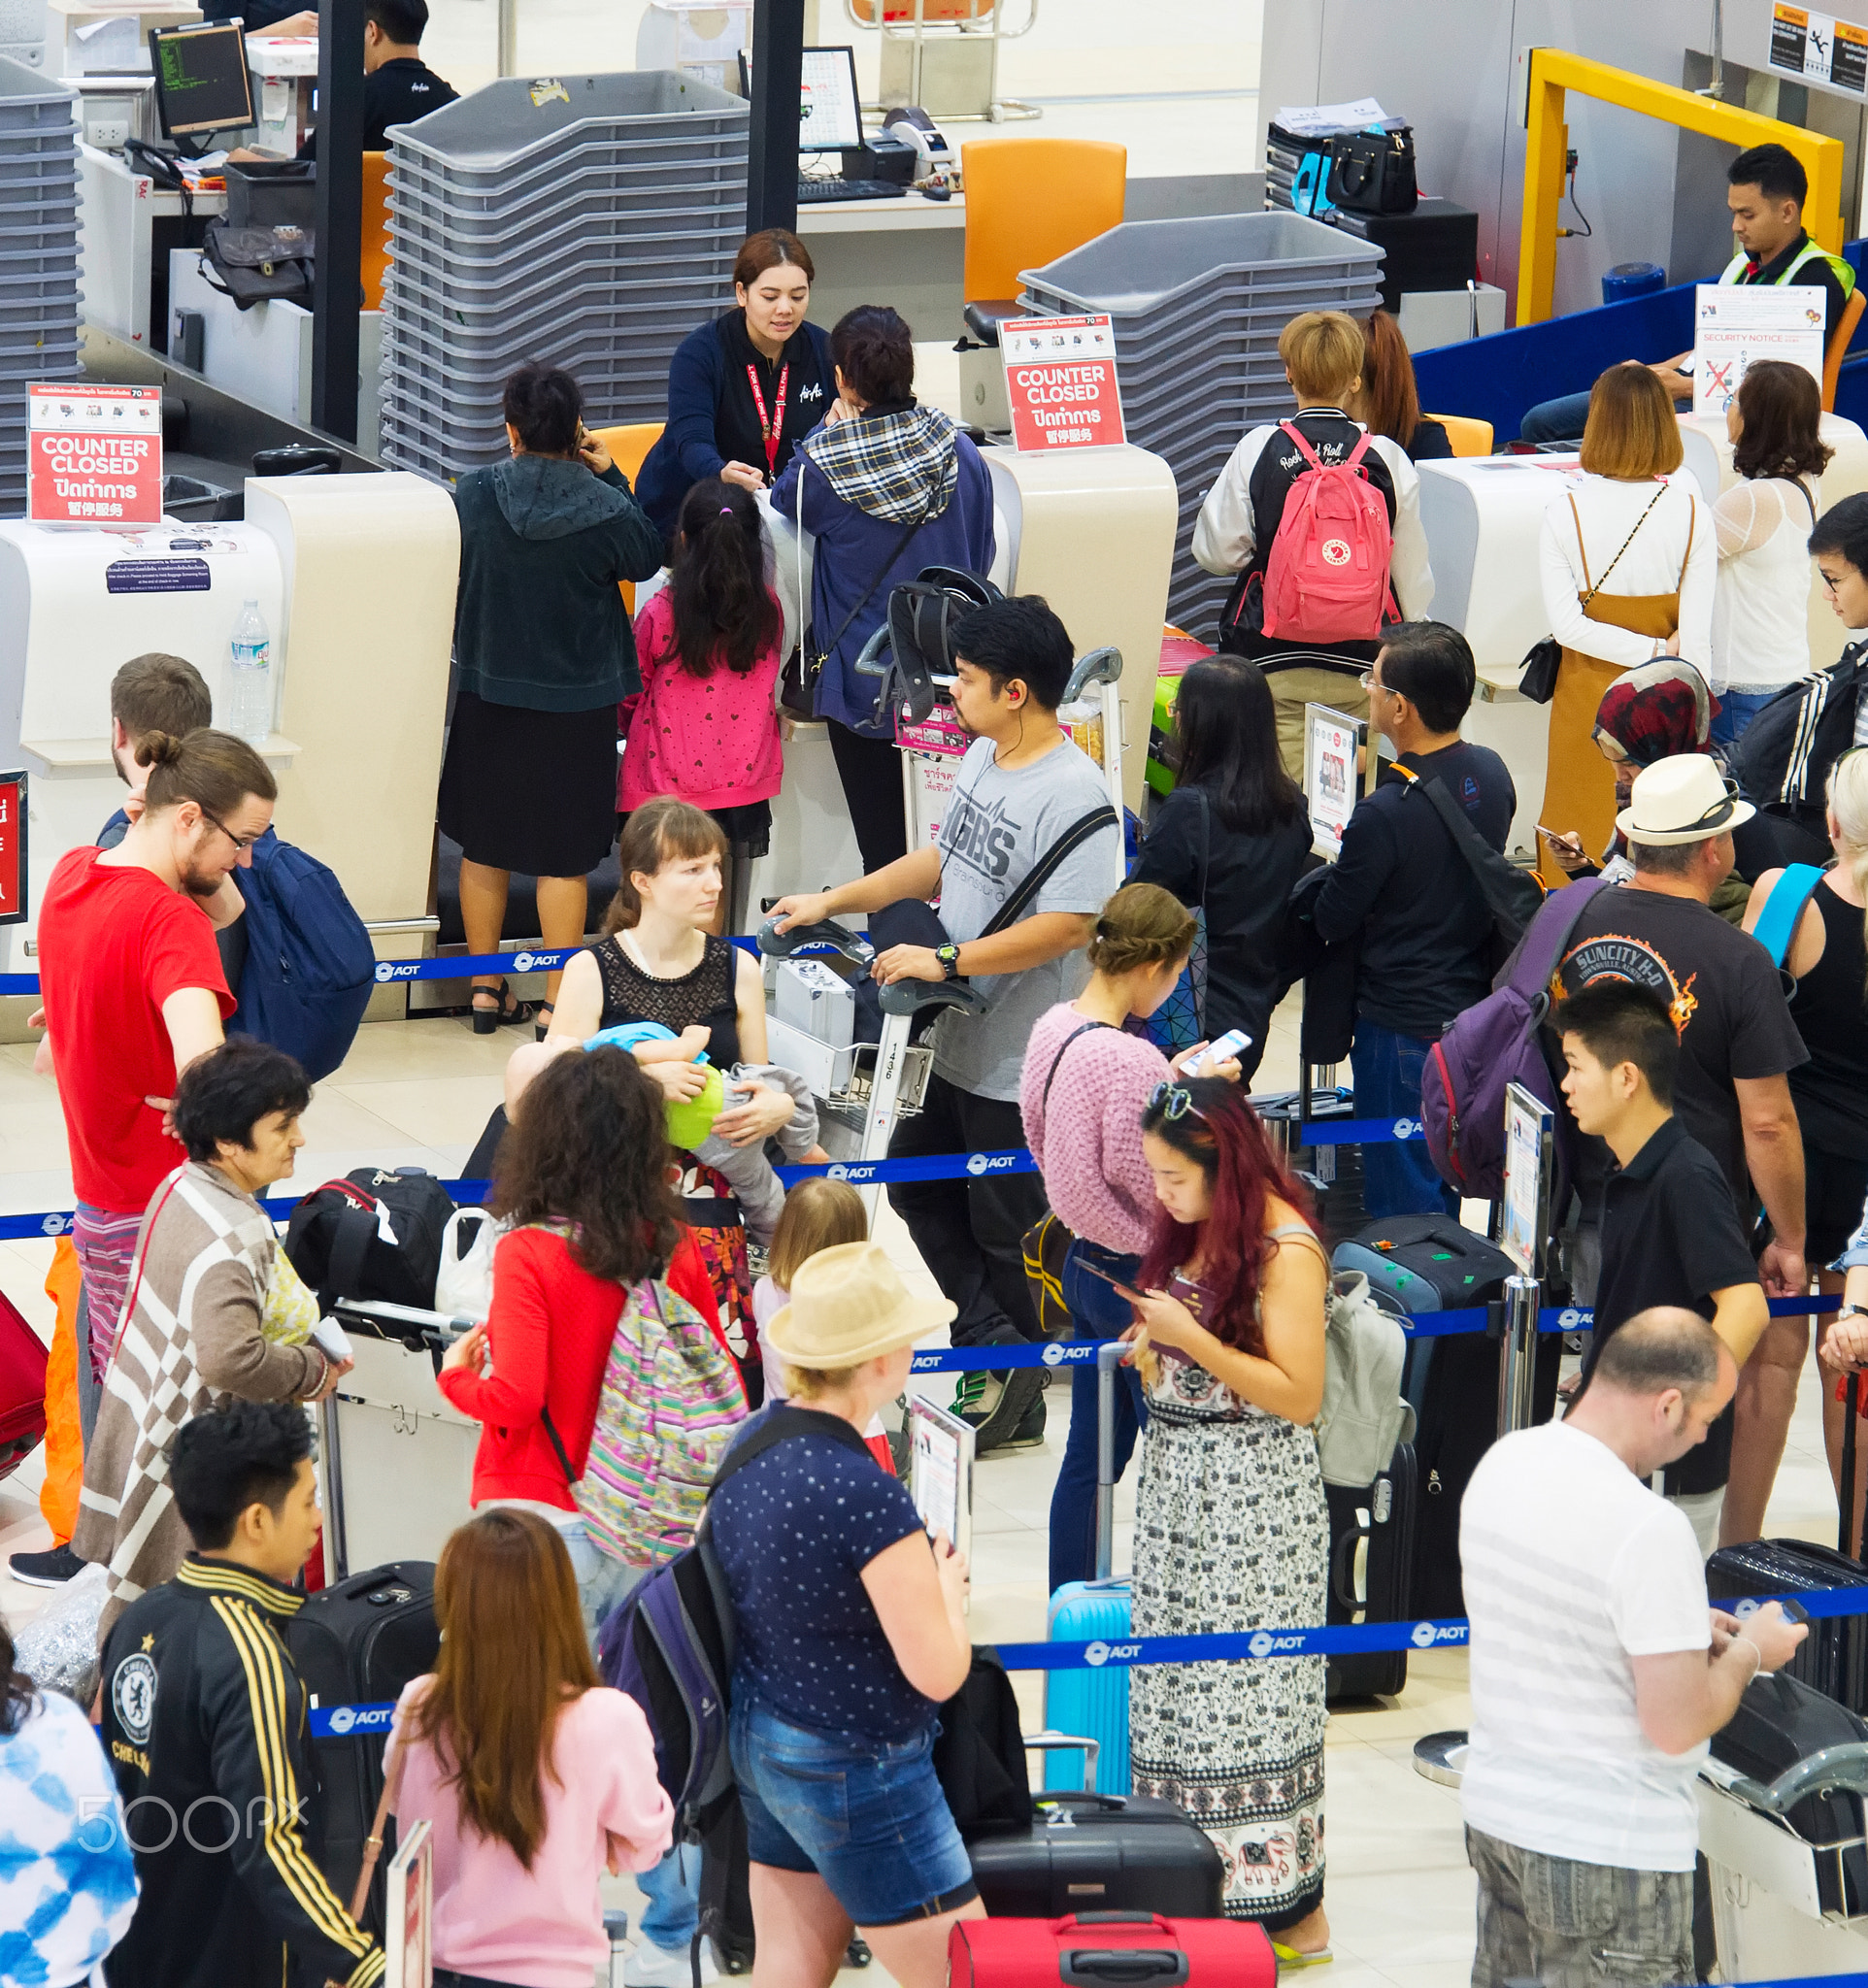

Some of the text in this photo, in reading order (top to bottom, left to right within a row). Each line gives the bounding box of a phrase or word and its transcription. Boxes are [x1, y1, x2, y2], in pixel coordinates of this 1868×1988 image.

[1704, 333, 1748, 342] SECURITY
[1750, 334, 1783, 343] NOTICE
[1017, 366, 1105, 387] COUNTER
[131, 388, 143, 397] 70
[1027, 384, 1099, 404] CLOSED
[1031, 407, 1101, 427] ปิดทำการ
[1046, 428, 1092, 444] 暂停服务
[42, 437, 149, 457] COUNTER
[1280, 448, 1302, 471] Rock
[1323, 443, 1344, 456] Roll
[50, 455, 139, 475] CLOSED
[53, 479, 137, 499] ปิดทำการ
[68, 501, 123, 516] 暂停服务
[534, 955, 560, 966] AOT
[1576, 945, 1664, 986] SUNCITY H-D
[394, 966, 420, 976] AOT
[988, 1157, 1016, 1168] AOT
[848, 1167, 876, 1178] AOT
[1064, 1346, 1093, 1359] AOT
[913, 1356, 943, 1368] AOT
[1437, 1626, 1468, 1640] AOT
[1274, 1636, 1306, 1650] AOT
[1110, 1645, 1143, 1659] AOT
[355, 1709, 390, 1725] AOT
